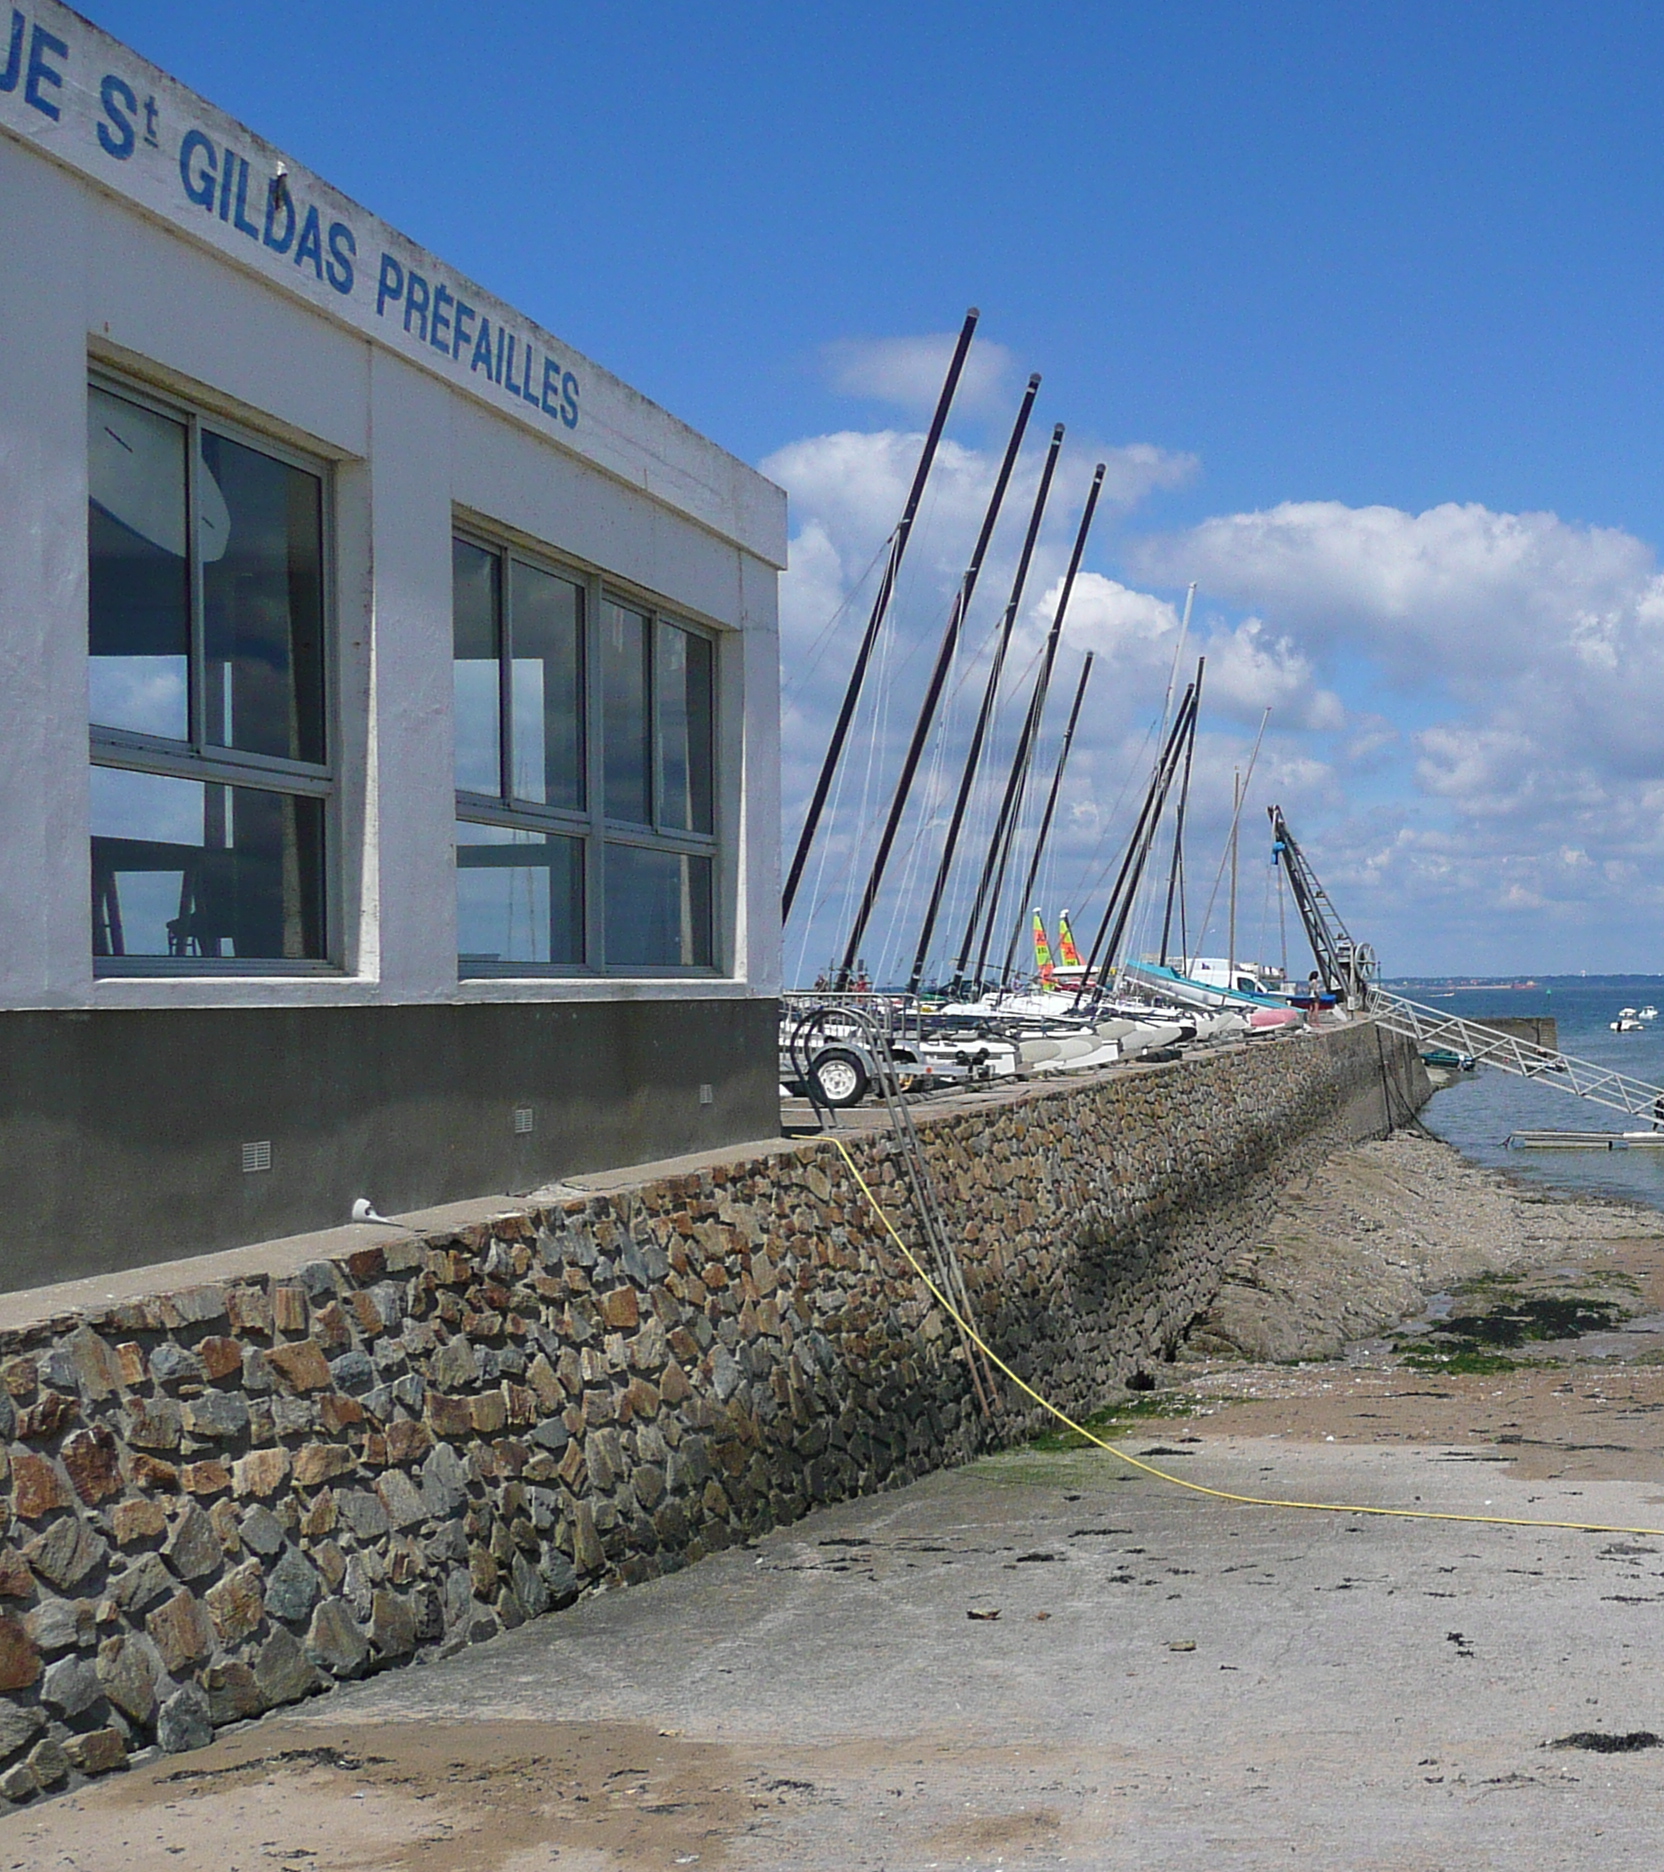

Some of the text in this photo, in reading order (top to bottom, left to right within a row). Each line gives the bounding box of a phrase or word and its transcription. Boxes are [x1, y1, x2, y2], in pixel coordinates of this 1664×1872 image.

[97, 74, 159, 160] St
[179, 129, 357, 295] GILDAS
[375, 252, 580, 430] PRÉFAILLES
